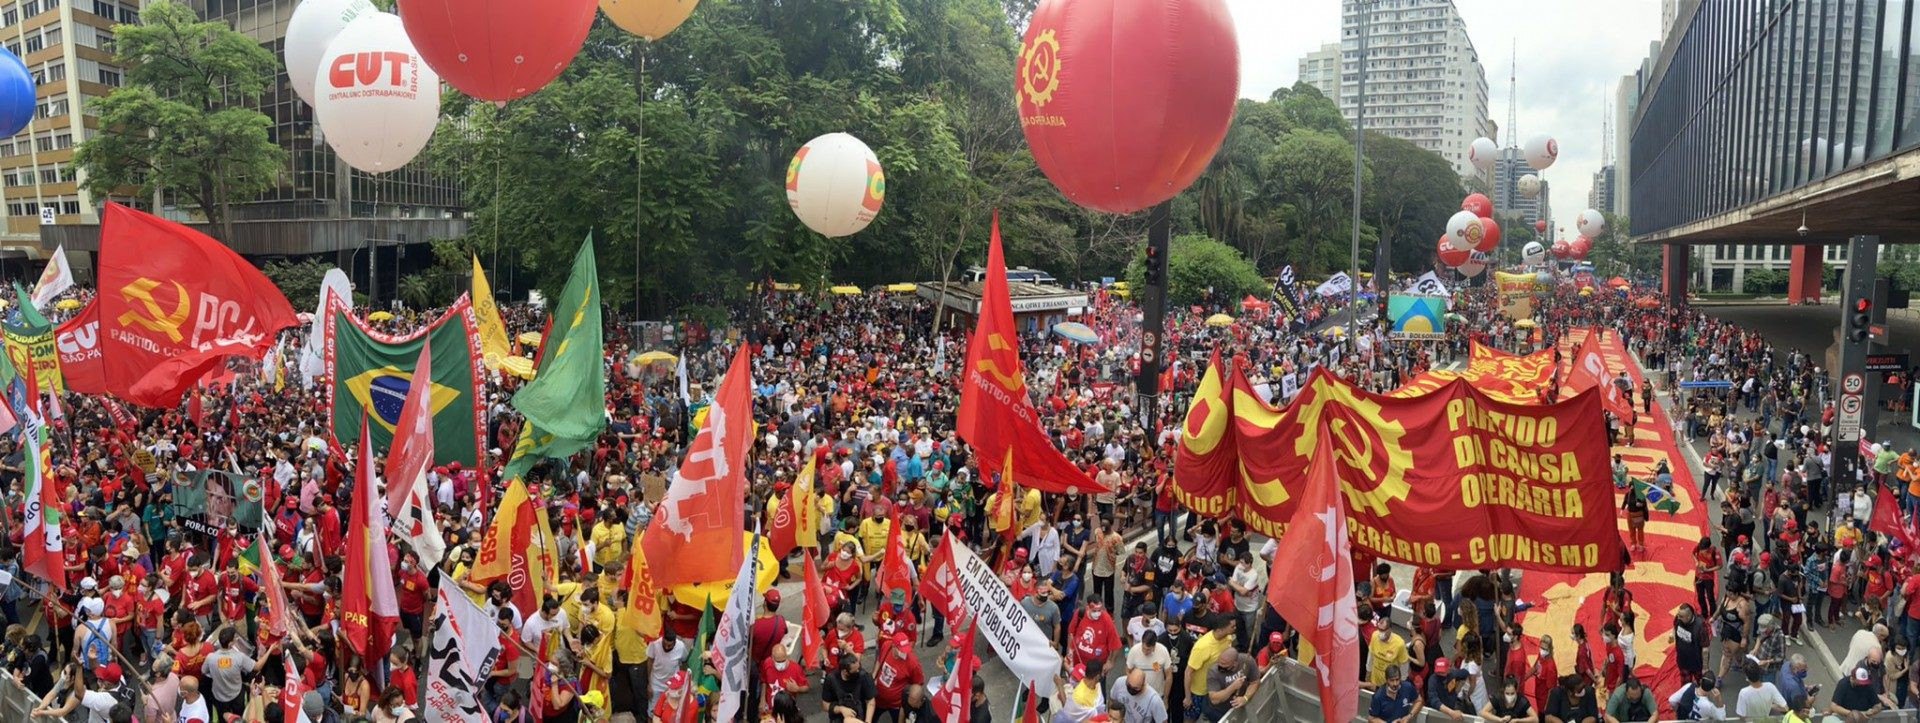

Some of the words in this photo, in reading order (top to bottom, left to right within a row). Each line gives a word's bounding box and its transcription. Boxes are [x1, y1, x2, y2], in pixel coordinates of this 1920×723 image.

[329, 51, 409, 88] CUT
[410, 55, 418, 93] BRASIL
[111, 329, 160, 353] PARTIDO
[163, 346, 187, 358] CO
[970, 369, 1011, 405] PARTIDO
[1846, 378, 1860, 387] 50
[1447, 397, 1557, 448] PARTIDO
[1453, 435, 1486, 469] DA
[1489, 438, 1582, 484] CAUSA
[1461, 472, 1583, 518] OPERÁRIA
[185, 519, 206, 533] FORA
[1346, 516, 1441, 566] PERÁRIO
[965, 555, 981, 578] EM
[978, 570, 1010, 612] DEFESA
[1006, 604, 1027, 633] DOS
[344, 611, 368, 628] PAR
[980, 603, 1021, 661] PÚBLICOS
